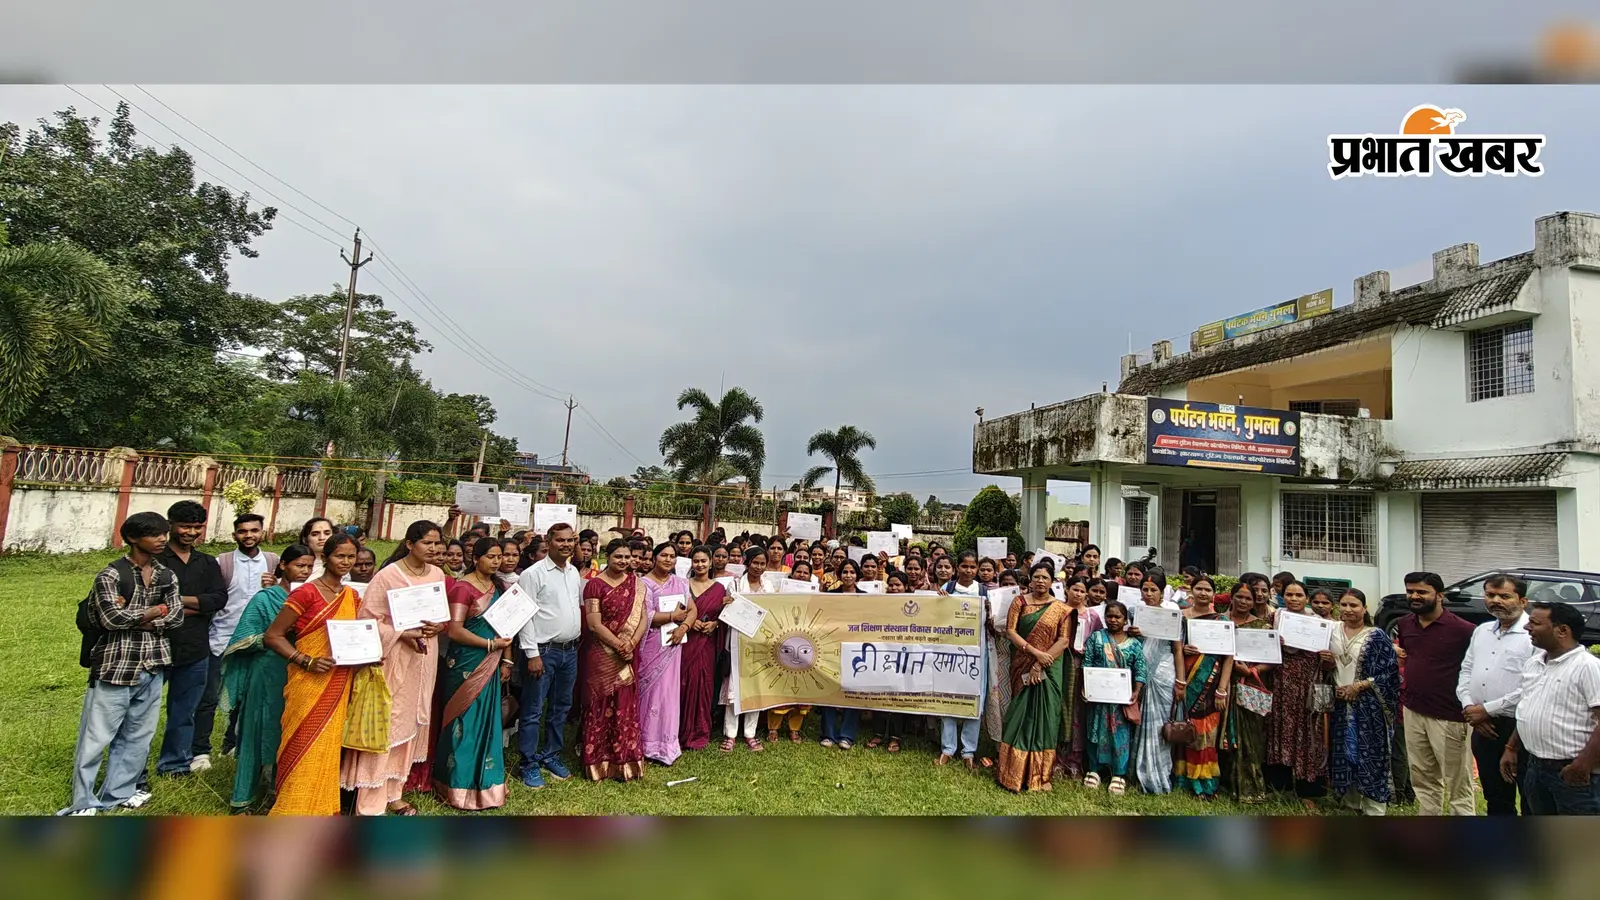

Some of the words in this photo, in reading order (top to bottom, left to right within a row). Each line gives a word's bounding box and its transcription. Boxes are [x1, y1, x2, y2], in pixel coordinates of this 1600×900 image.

[1270, 303, 1296, 320] गुमला
[1169, 404, 1207, 430] पर्यटन
[1208, 412, 1241, 435] भवन,
[1244, 415, 1281, 440] गुमला
[847, 624, 860, 632] जन
[861, 622, 882, 633] शिक्षण
[884, 623, 908, 633] संस्थान
[910, 623, 932, 634] विकास
[933, 625, 953, 635] भारती
[954, 628, 975, 637] गुमला
[932, 646, 981, 680] समारोह
